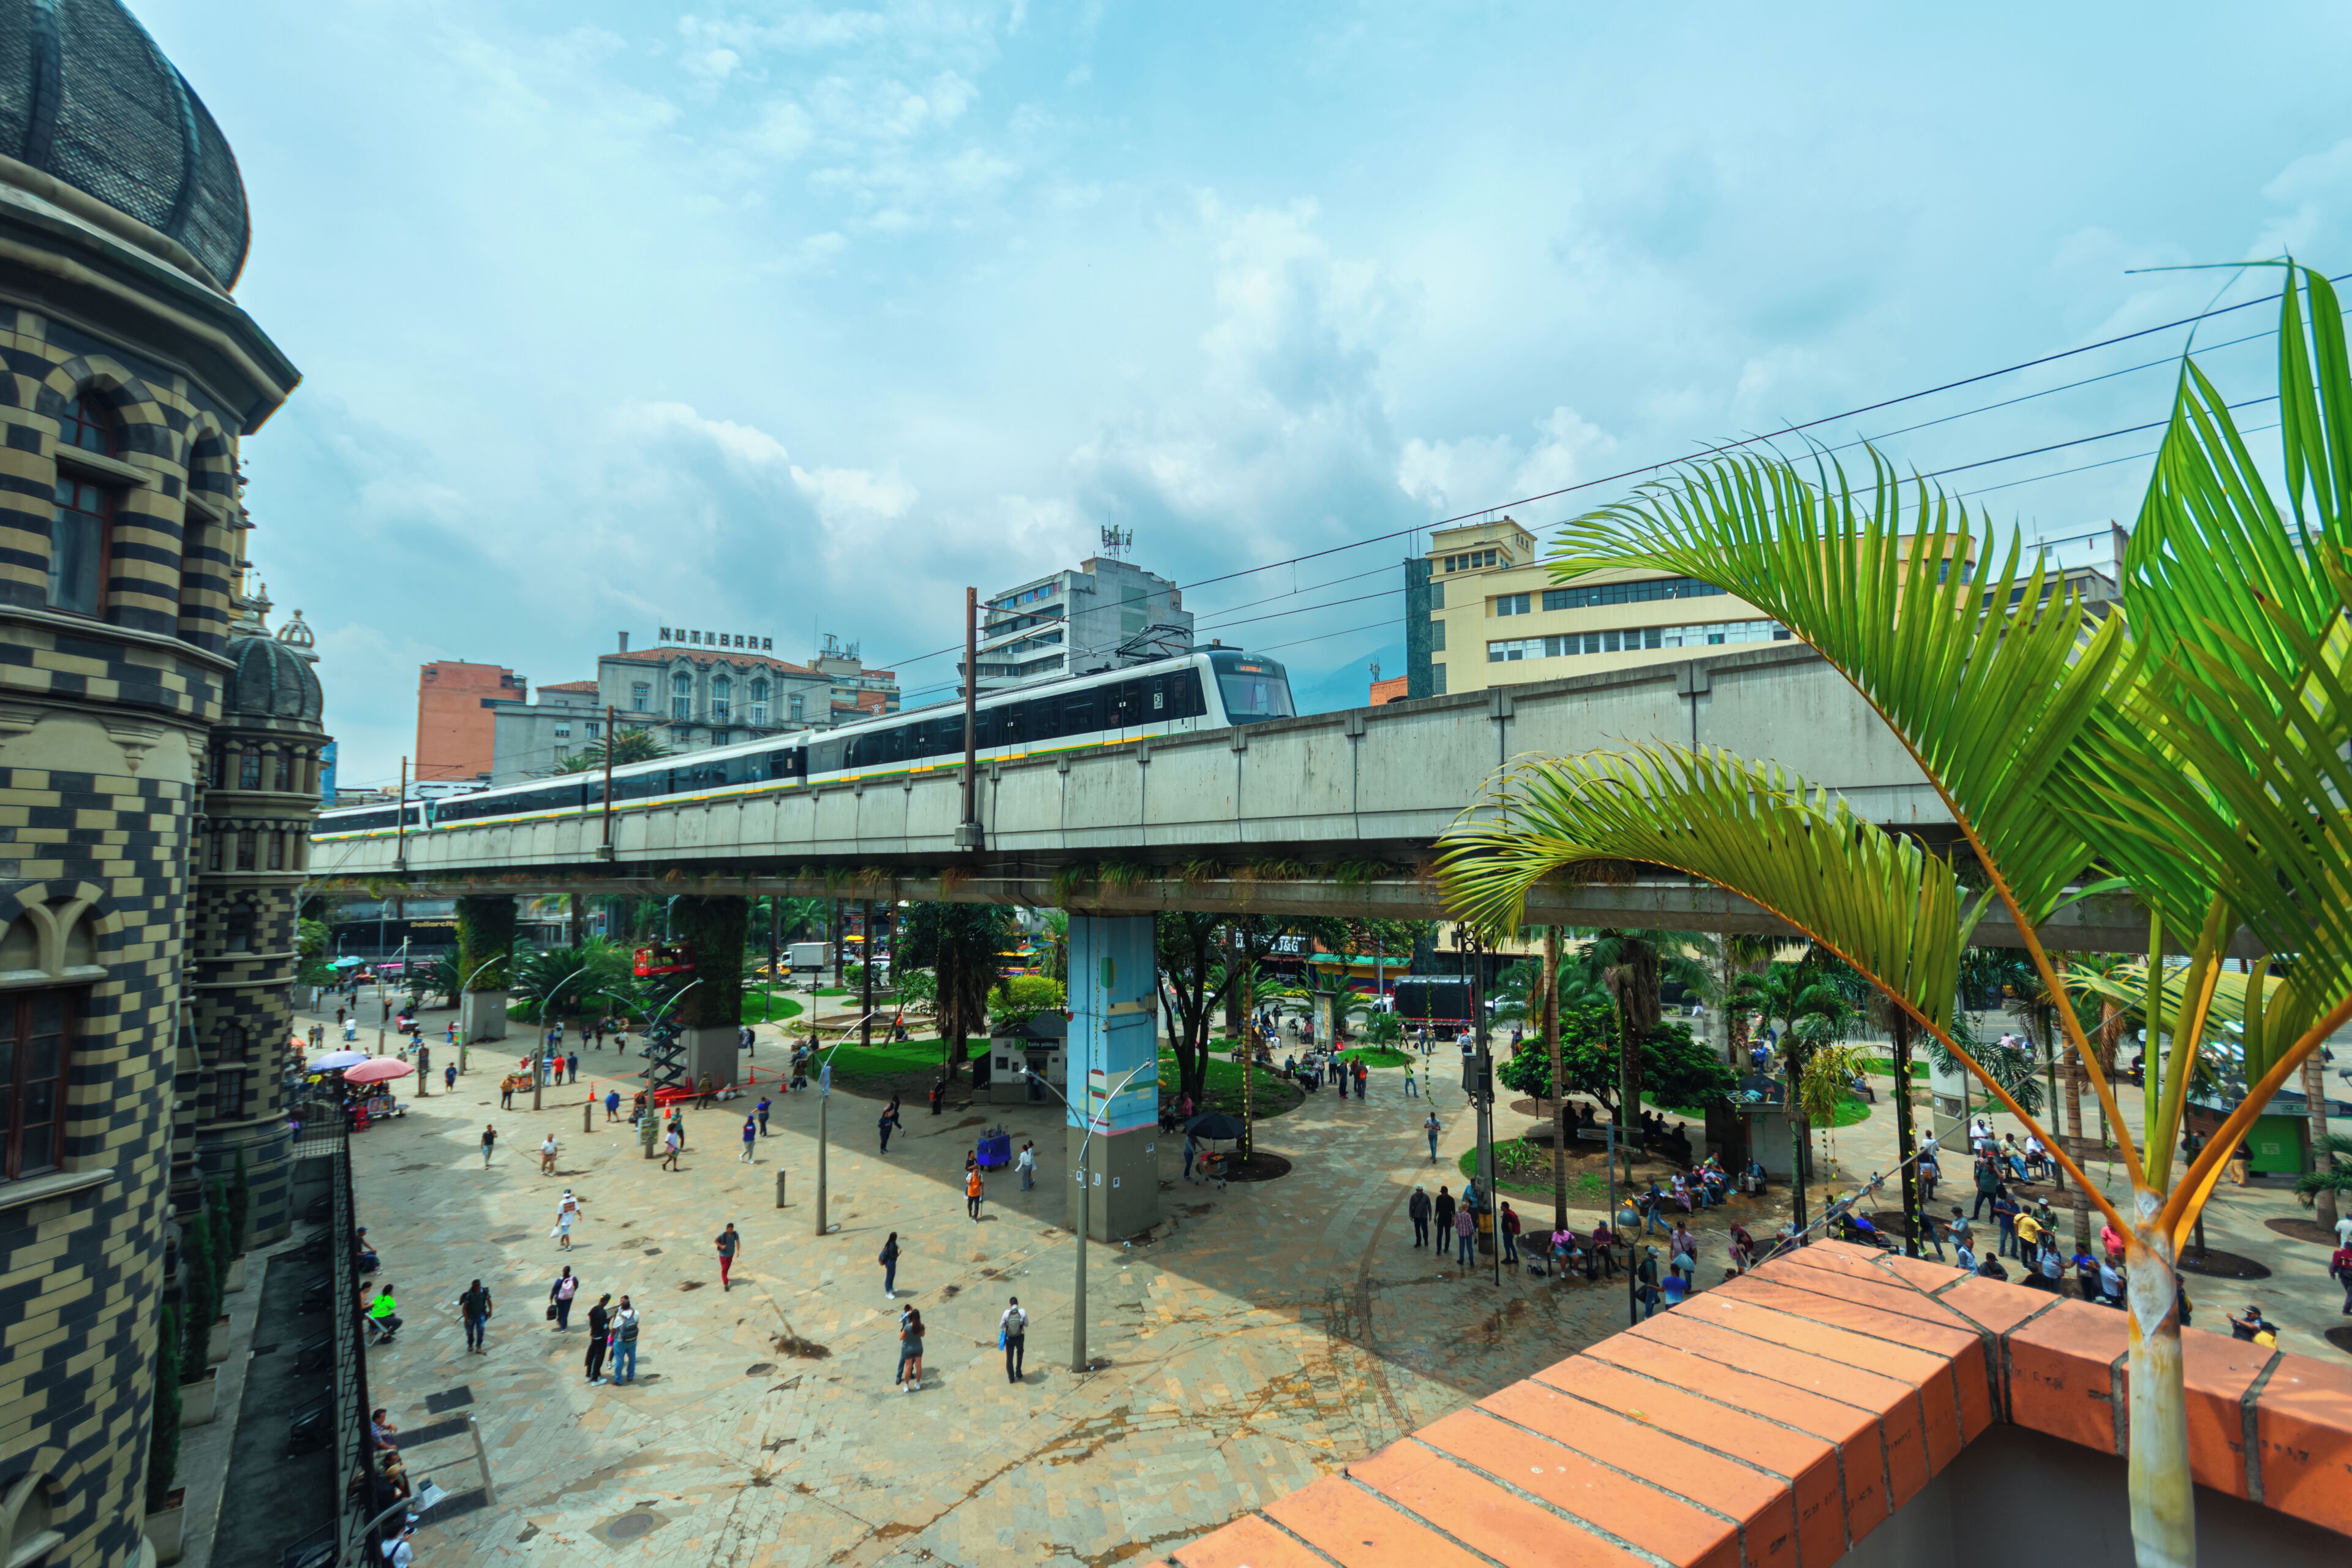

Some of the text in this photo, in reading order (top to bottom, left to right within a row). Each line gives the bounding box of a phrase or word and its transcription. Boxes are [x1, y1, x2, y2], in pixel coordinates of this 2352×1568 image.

[660, 627, 772, 650] NUTIBARA
[1278, 940, 1298, 952] J&G
[2280, 1104, 2304, 1113] gana
